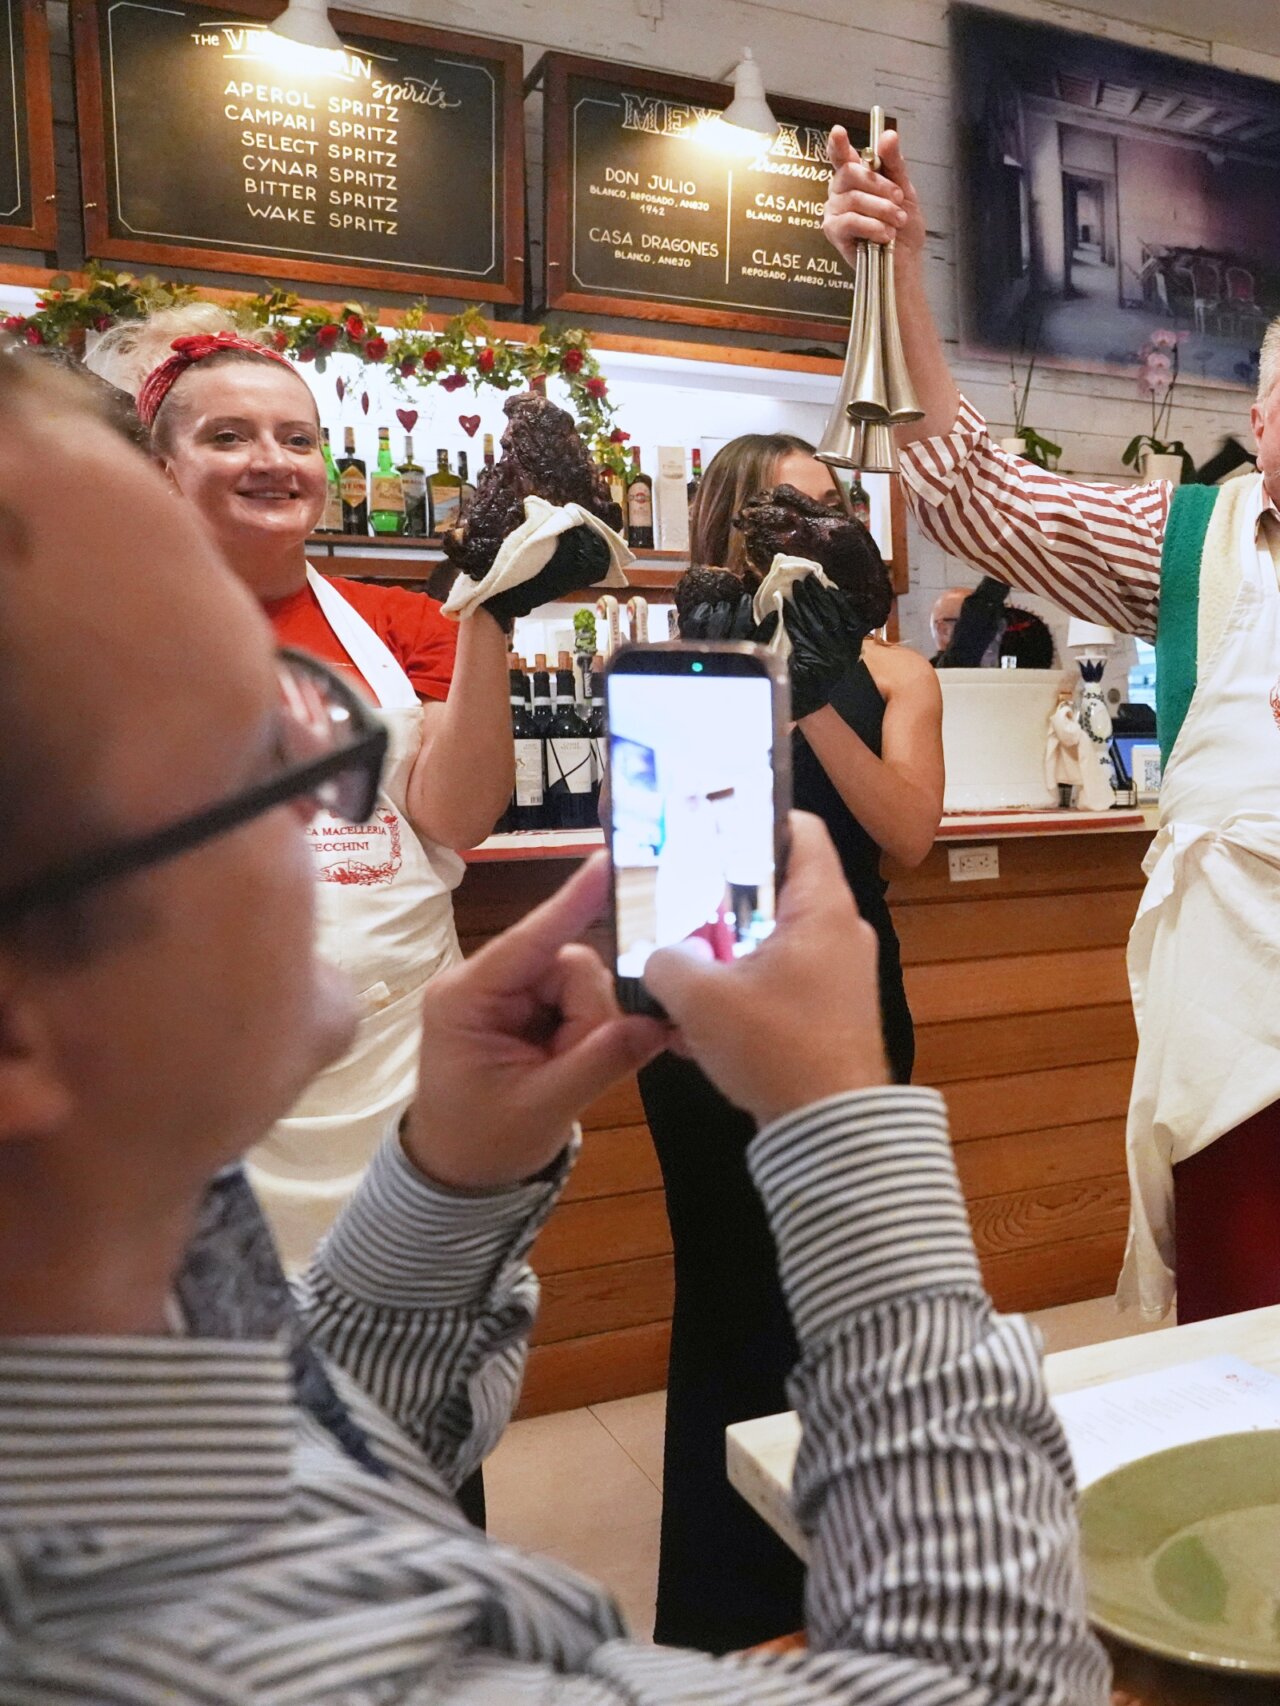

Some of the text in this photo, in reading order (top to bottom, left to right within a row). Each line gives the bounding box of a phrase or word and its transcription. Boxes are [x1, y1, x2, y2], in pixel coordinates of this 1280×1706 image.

[224, 80, 399, 122] APEROL SPRITZ
[371, 76, 462, 109] spirits
[224, 104, 398, 145] CAMPARI SPRITZ
[241, 131, 397, 167] SELECT SPRITZ
[243, 155, 397, 190] CYNAR SPRITZ
[605, 167, 696, 195] DON JULIO
[245, 178, 398, 212] BITTER SPRITZ
[639, 204, 665, 216] 1942
[755, 193, 825, 216] CASAMIG
[247, 202, 398, 235] WAKE SPRITZ
[746, 209, 782, 223] BLANCO
[589, 227, 719, 258] CASA DRAGONES
[752, 249, 842, 276] CLASE AZUL
[322, 825, 387, 836] MACELLERIA
